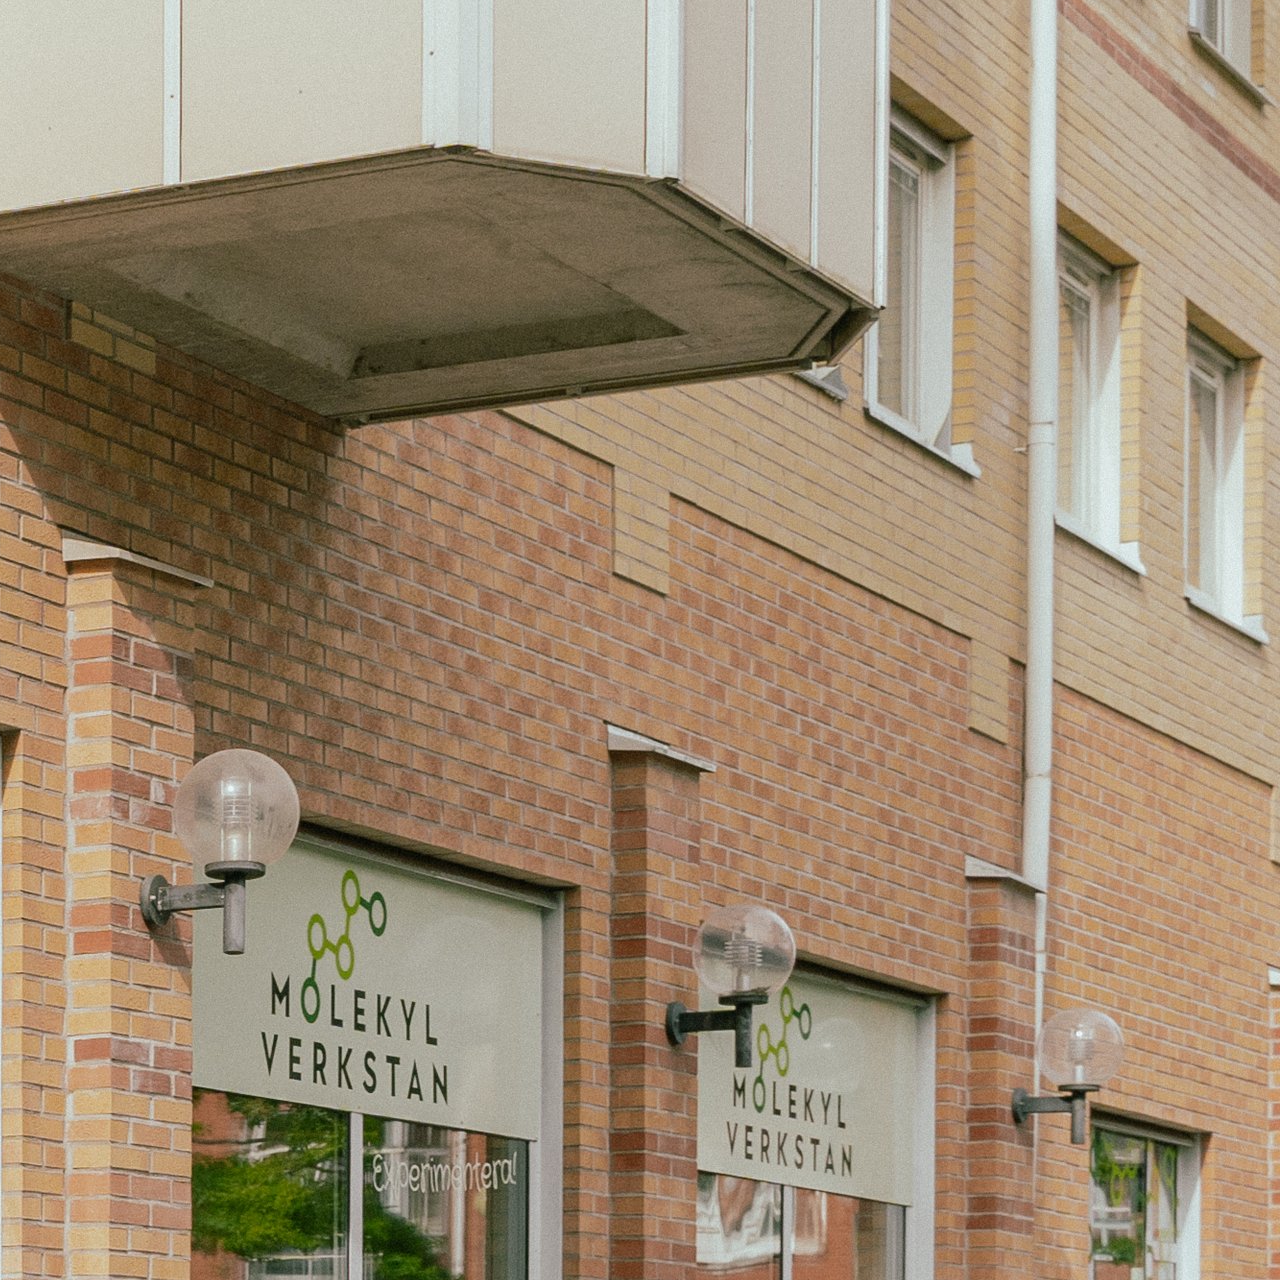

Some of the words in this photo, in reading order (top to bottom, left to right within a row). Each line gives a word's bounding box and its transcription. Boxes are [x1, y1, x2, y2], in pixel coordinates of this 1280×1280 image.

[271, 972, 438, 1046] MOLEKYL
[261, 1032, 448, 1105] VERKSTAN
[733, 1072, 846, 1129] MOLEKYL
[373, 1151, 517, 1199] Experimentera!
[727, 1121, 852, 1178] VERKSTAN
